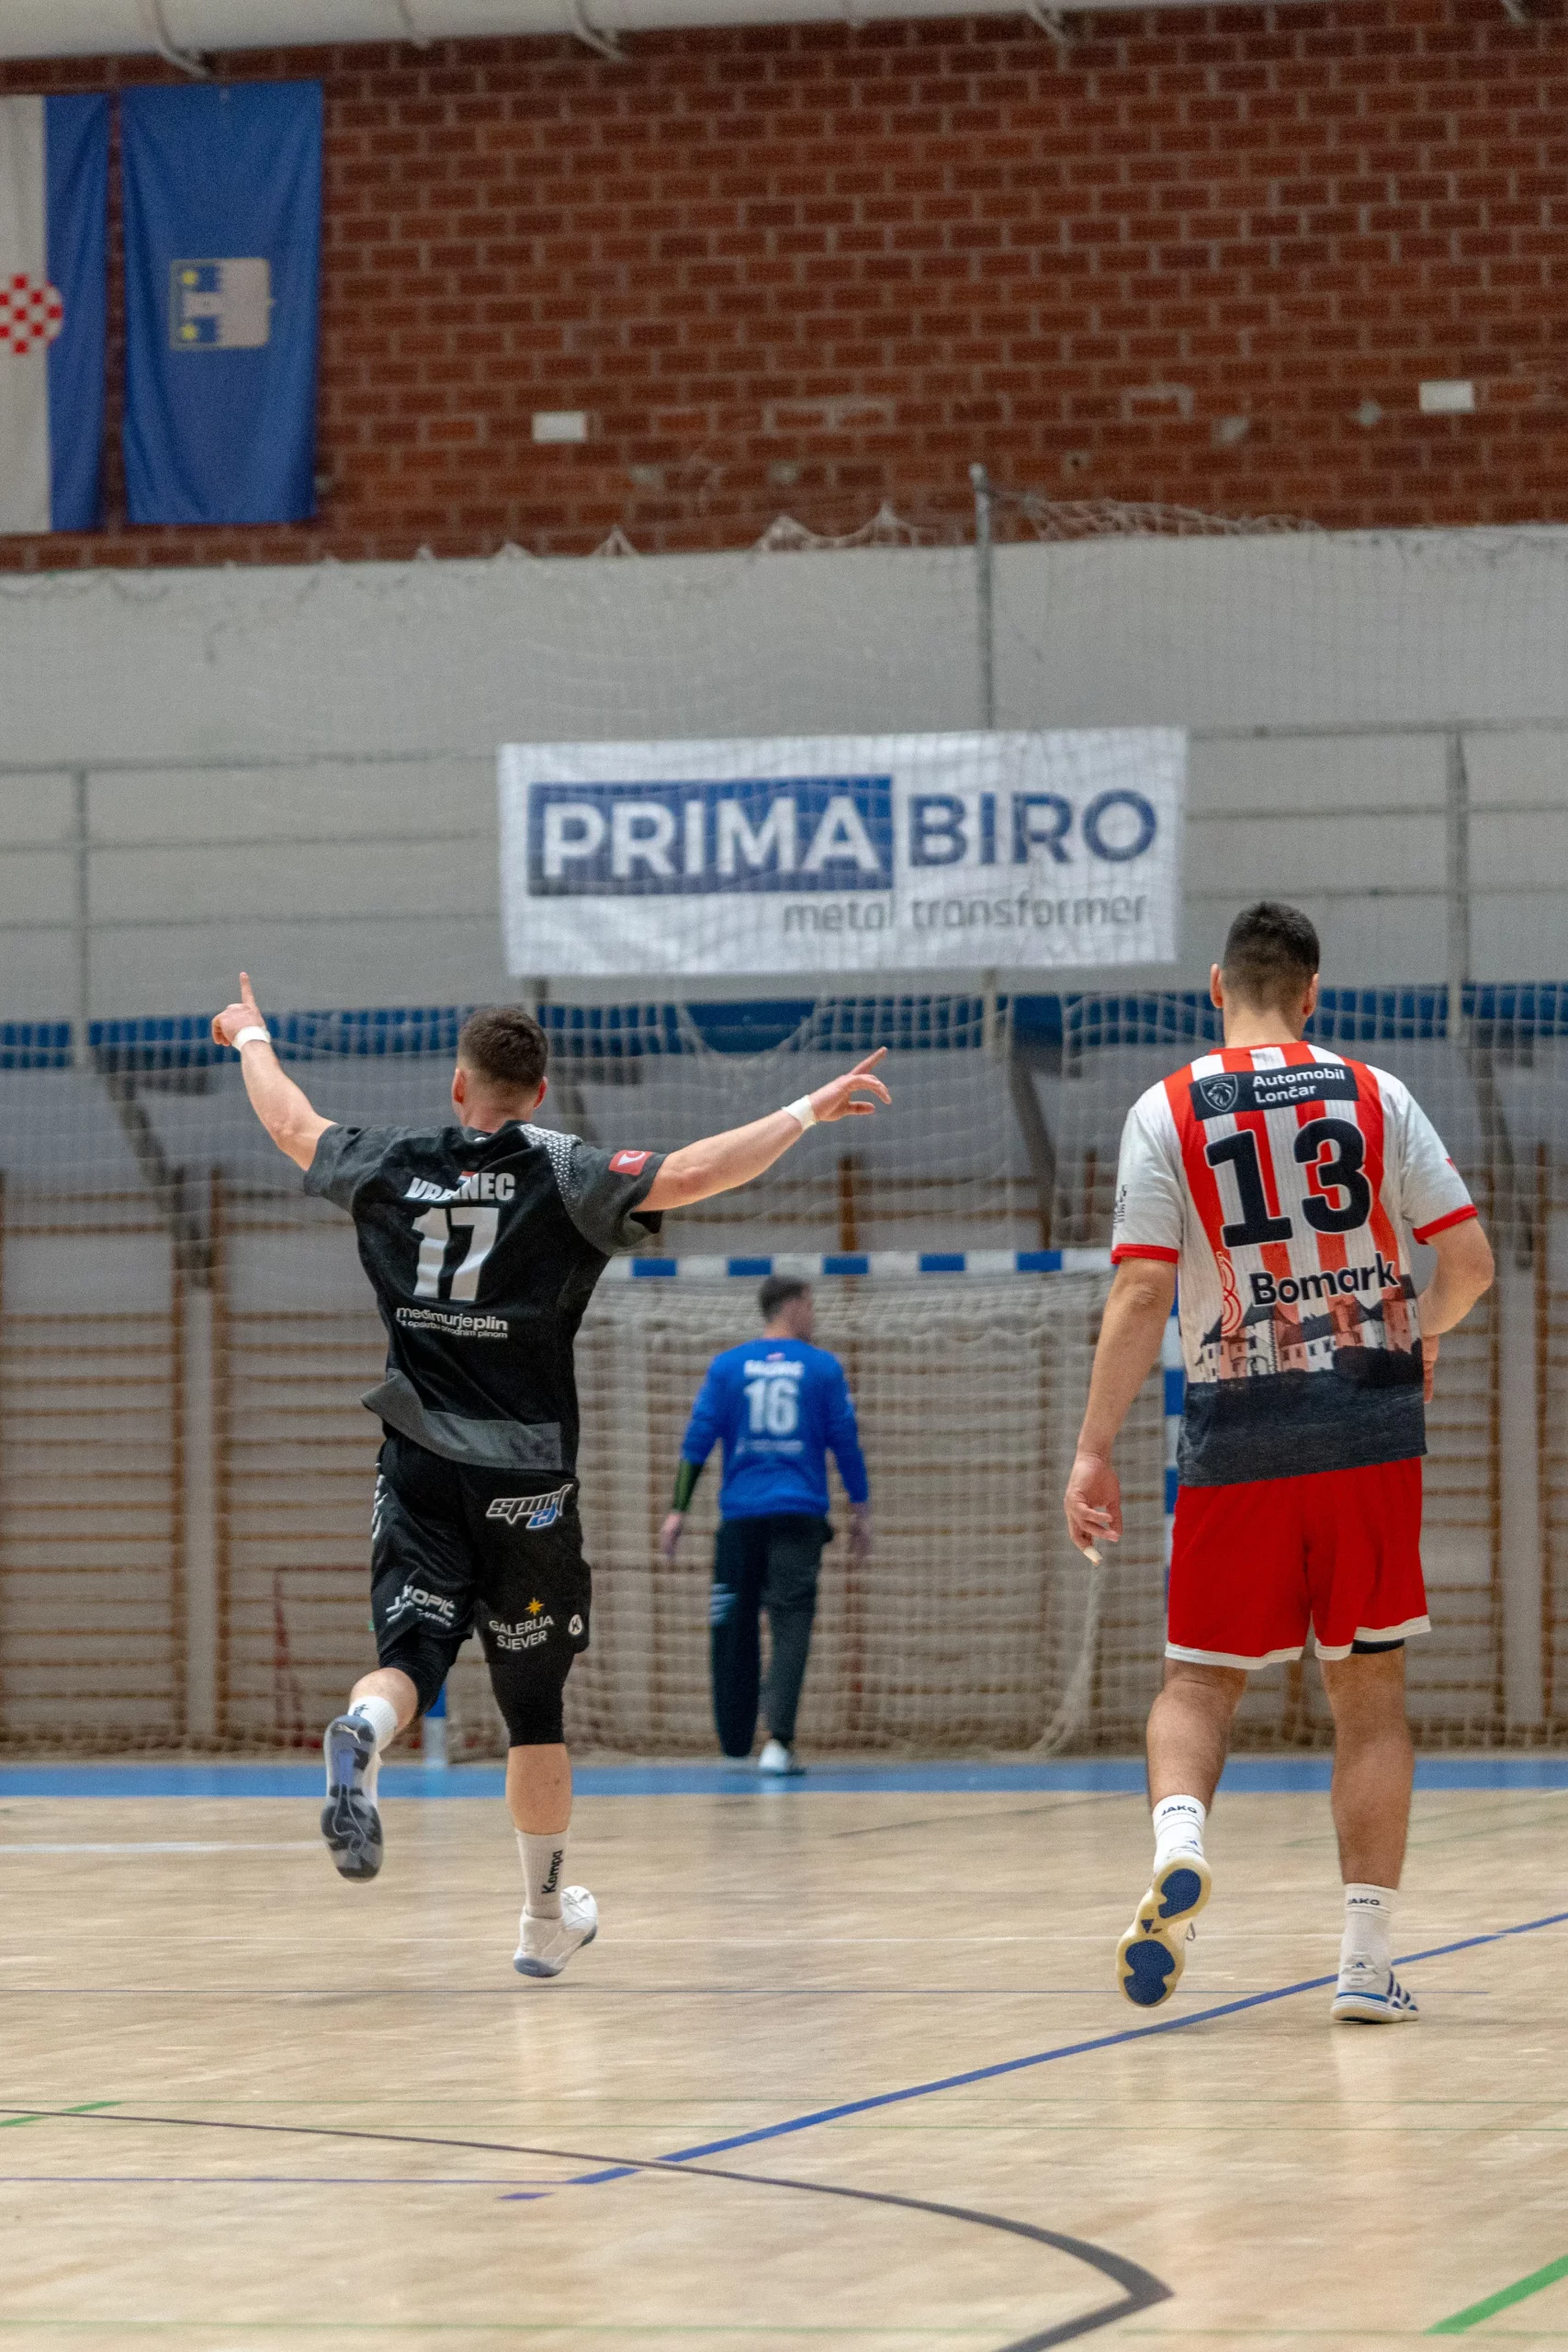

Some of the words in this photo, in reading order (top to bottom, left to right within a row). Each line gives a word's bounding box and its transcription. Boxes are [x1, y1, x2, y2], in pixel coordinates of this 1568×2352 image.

[543, 794, 881, 878] PRIMA
[907, 787, 1158, 869] BIRO
[782, 892, 897, 933] metal
[910, 889, 1148, 930] transformer
[1252, 1068, 1346, 1088] Automobil
[1255, 1085, 1317, 1104] Lončar
[1205, 1117, 1371, 1248] 13
[412, 1206, 500, 1302] 17
[1249, 1251, 1400, 1306] Bomark
[743, 1377, 799, 1435] 16
[489, 1615, 554, 1635] GALERIJA
[496, 1630, 547, 1650] SJEVER
[1161, 1804, 1198, 1816] JAKO
[541, 1849, 564, 1894] Kempa
